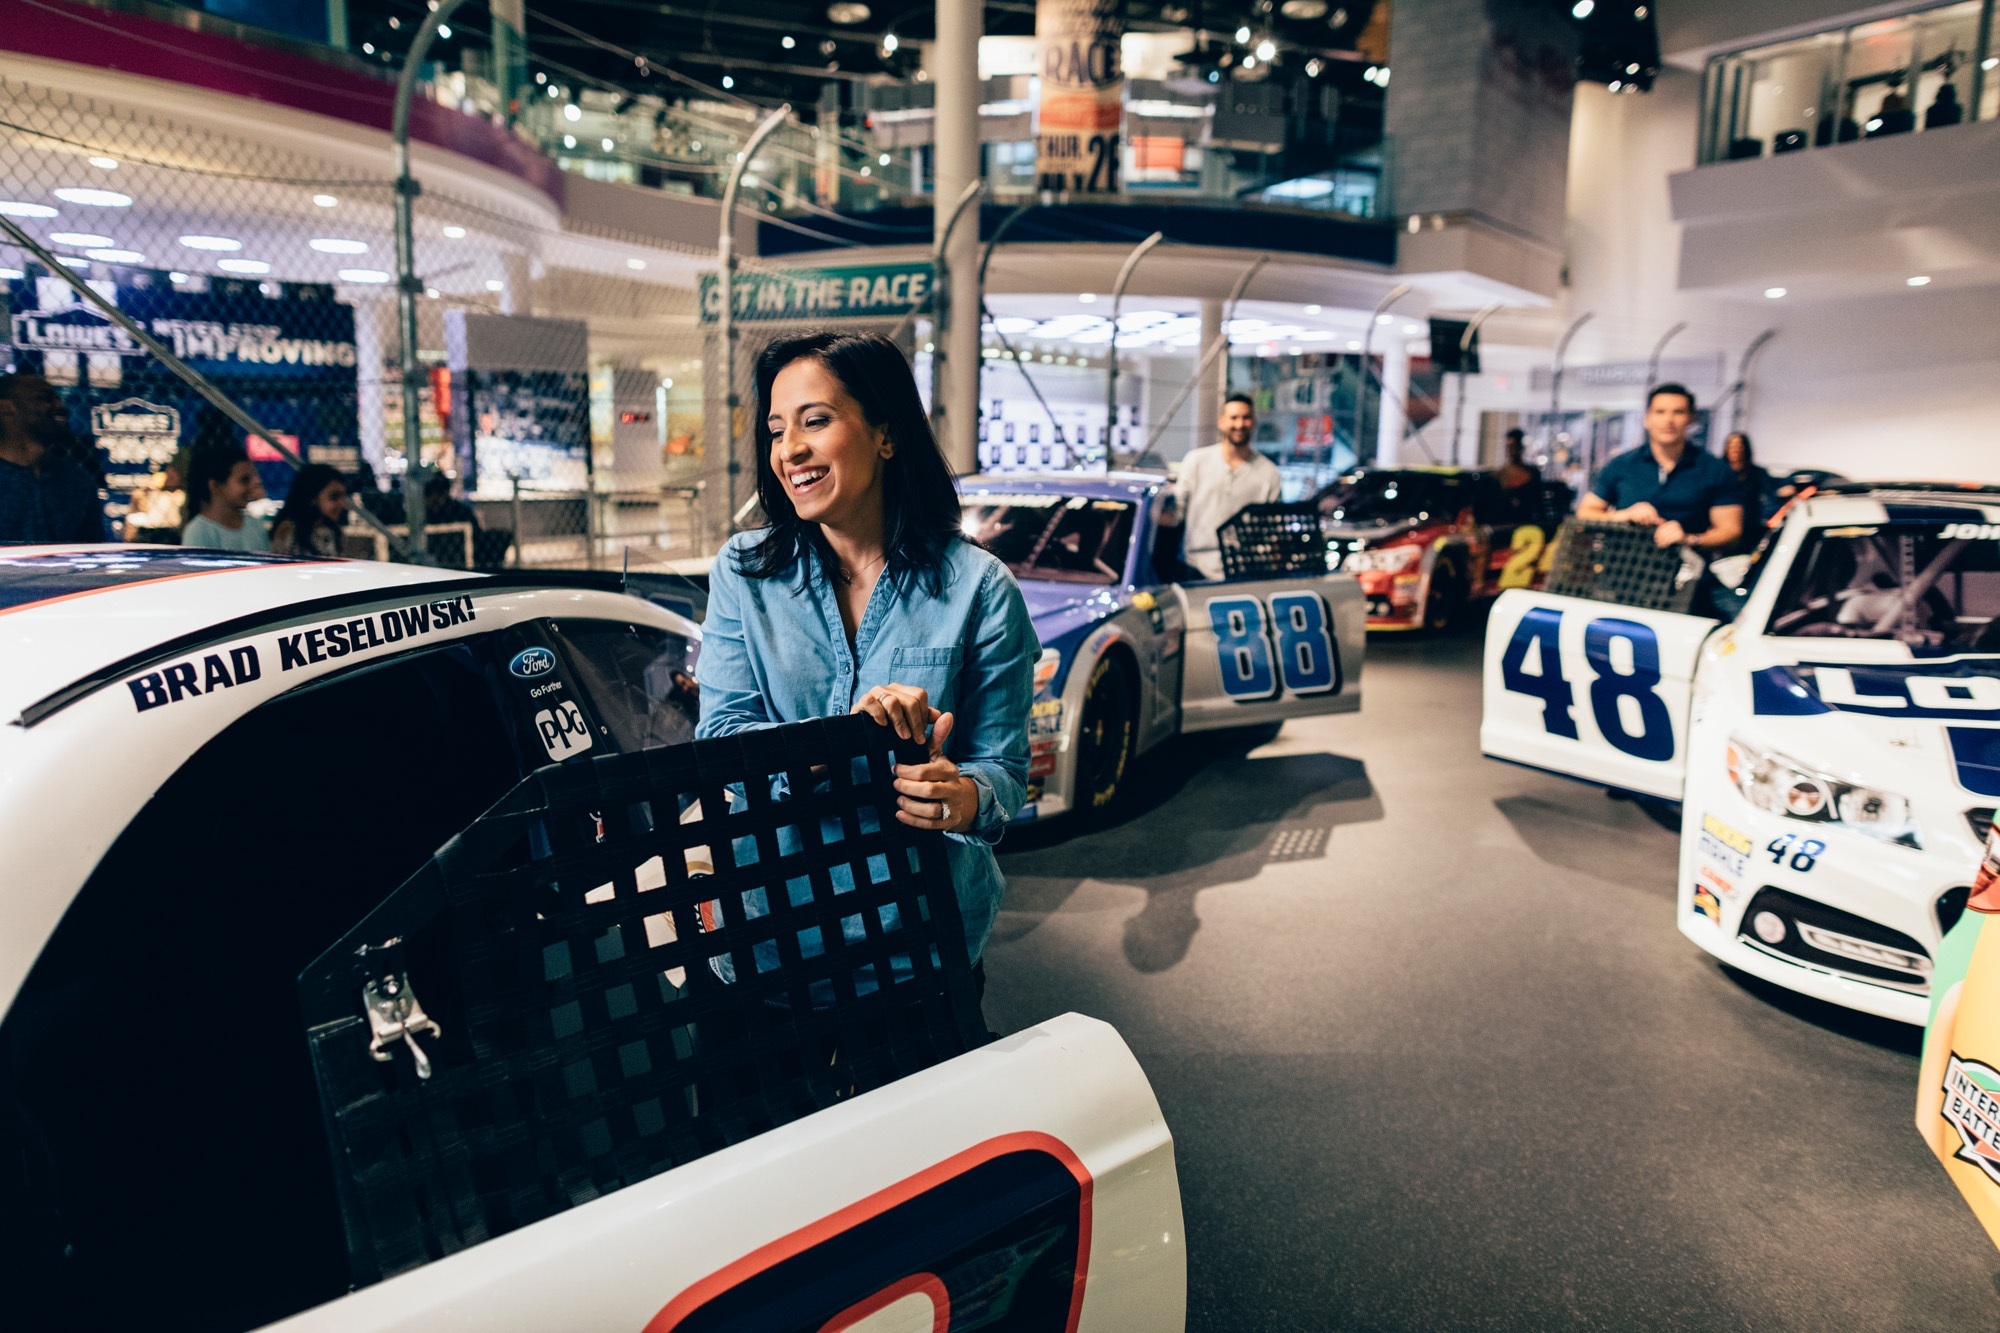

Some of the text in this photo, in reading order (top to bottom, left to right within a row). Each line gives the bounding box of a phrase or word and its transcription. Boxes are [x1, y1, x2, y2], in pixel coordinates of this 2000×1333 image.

[1046, 41, 1115, 88] RACE
[704, 273, 927, 314] GT IN THE RACE
[127, 595, 476, 712] BRAD KESELOWSKI
[522, 651, 550, 675] Ford
[1205, 590, 1342, 700] 88
[530, 681, 563, 698] Go Further
[1501, 607, 1675, 761] 48
[539, 705, 587, 750] PPG
[1766, 834, 1826, 872] 48
[1952, 1070, 2000, 1123] INTER
